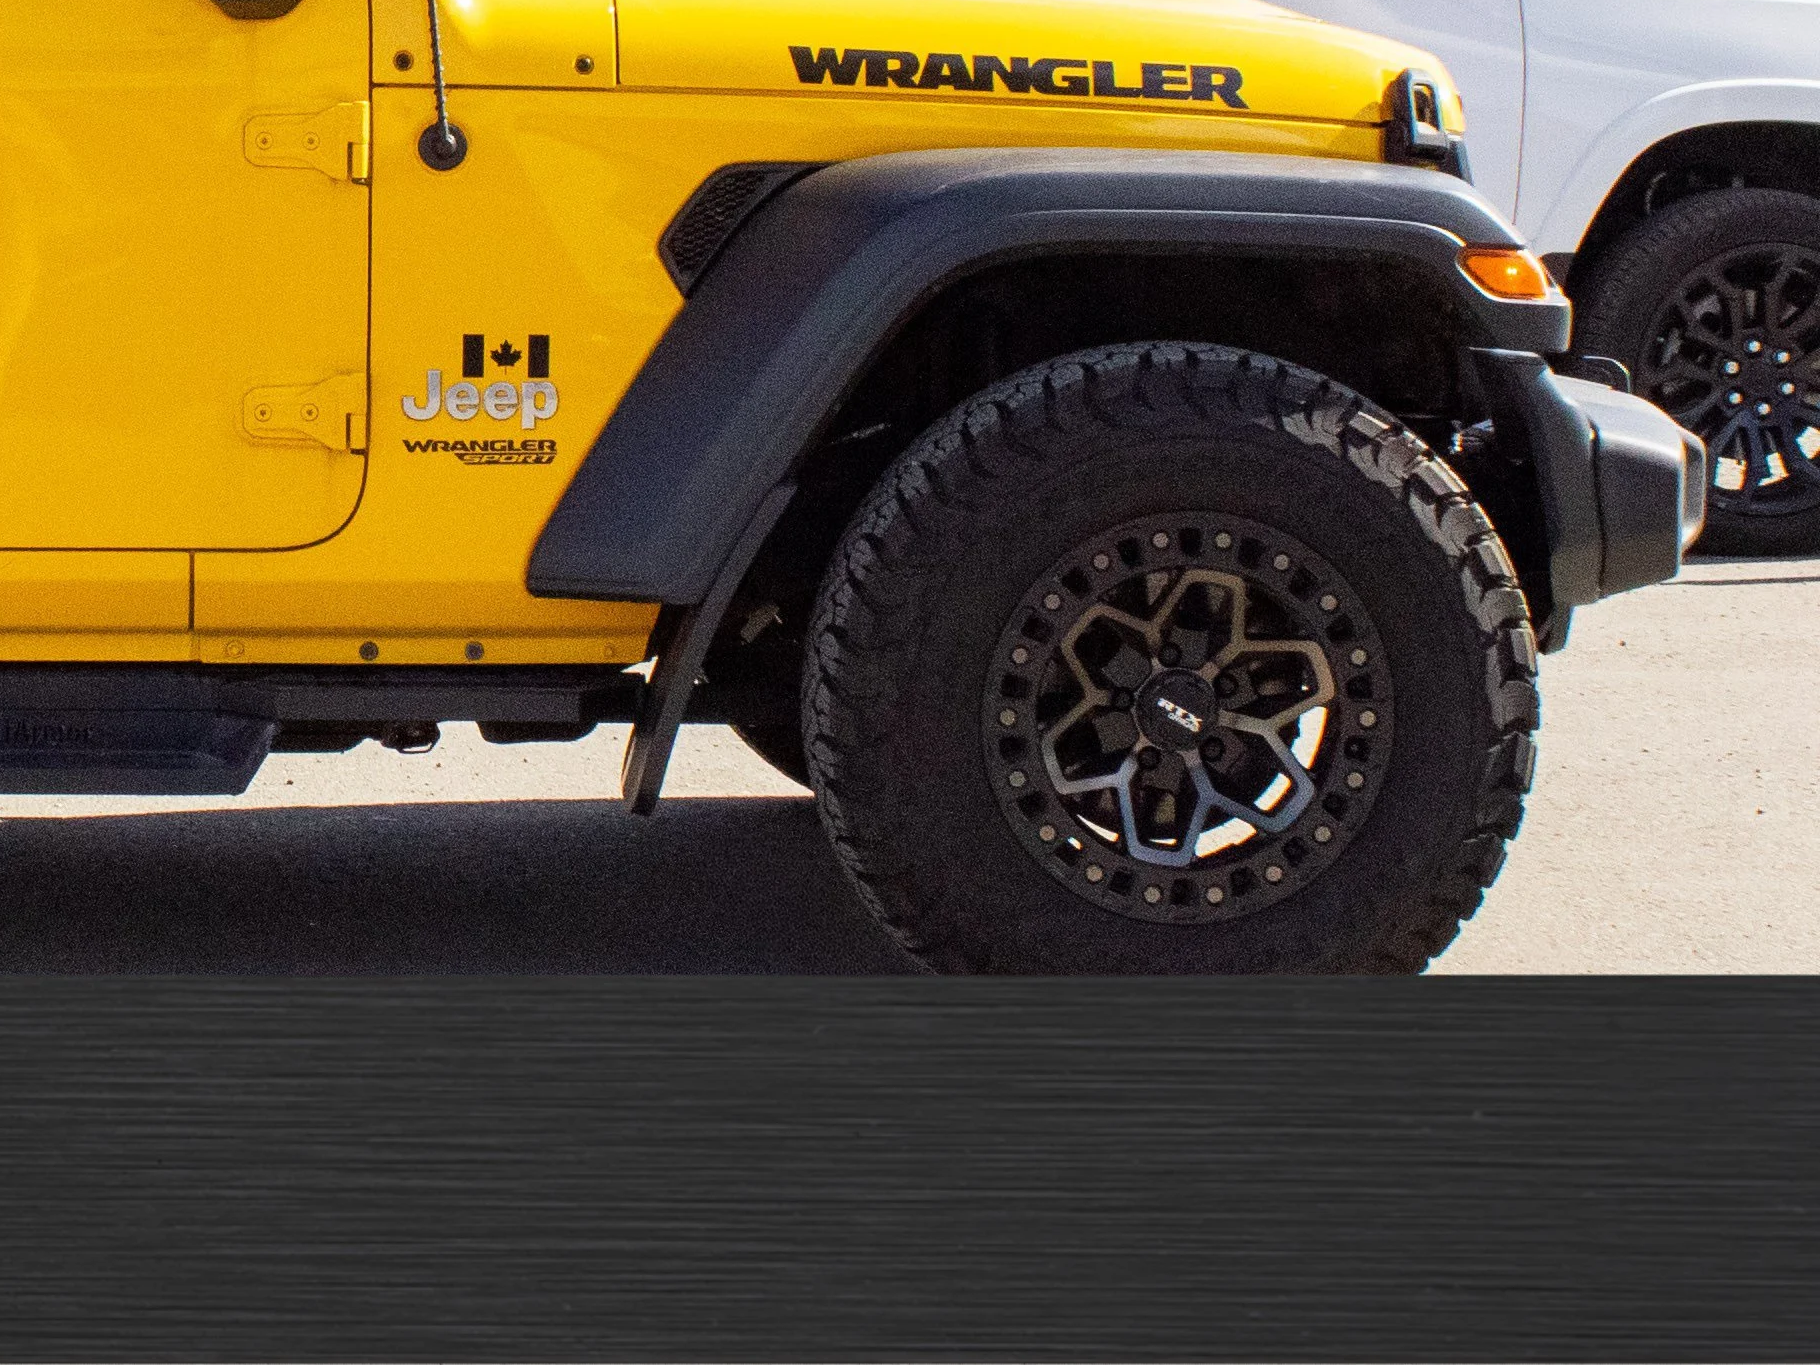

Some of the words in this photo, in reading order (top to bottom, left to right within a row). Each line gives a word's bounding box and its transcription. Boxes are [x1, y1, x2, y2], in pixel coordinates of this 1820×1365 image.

[787, 45, 1251, 110] WRANGLER
[401, 368, 559, 430] Jeep
[403, 439, 557, 453] WRANGLER
[459, 452, 554, 465] SPORT
